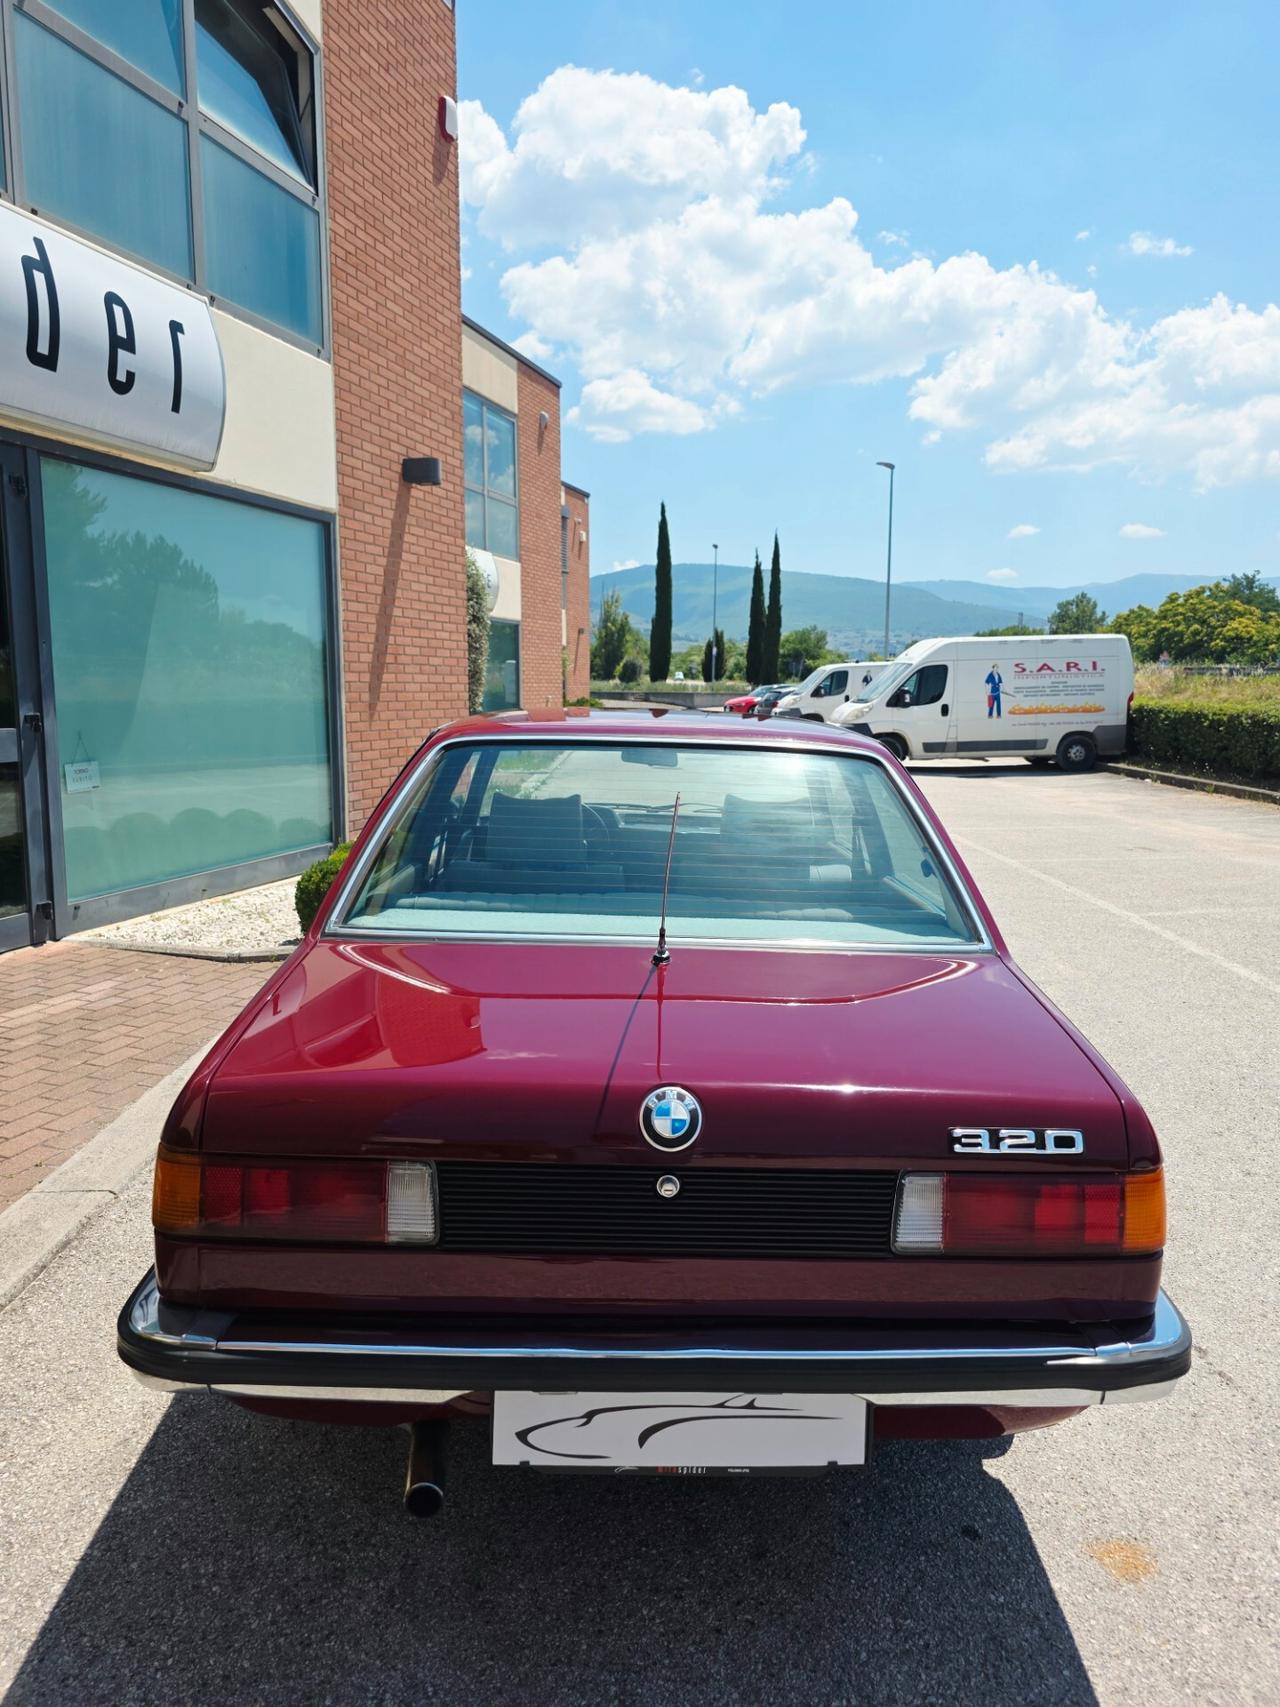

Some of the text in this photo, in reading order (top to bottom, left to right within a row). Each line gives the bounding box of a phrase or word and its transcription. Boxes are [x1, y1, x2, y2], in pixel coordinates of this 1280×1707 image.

[21, 236, 185, 414] der
[1013, 661, 1105, 673] S.A.R.I.
[647, 1090, 697, 1111] BMW
[952, 1128, 1083, 1154] 320
